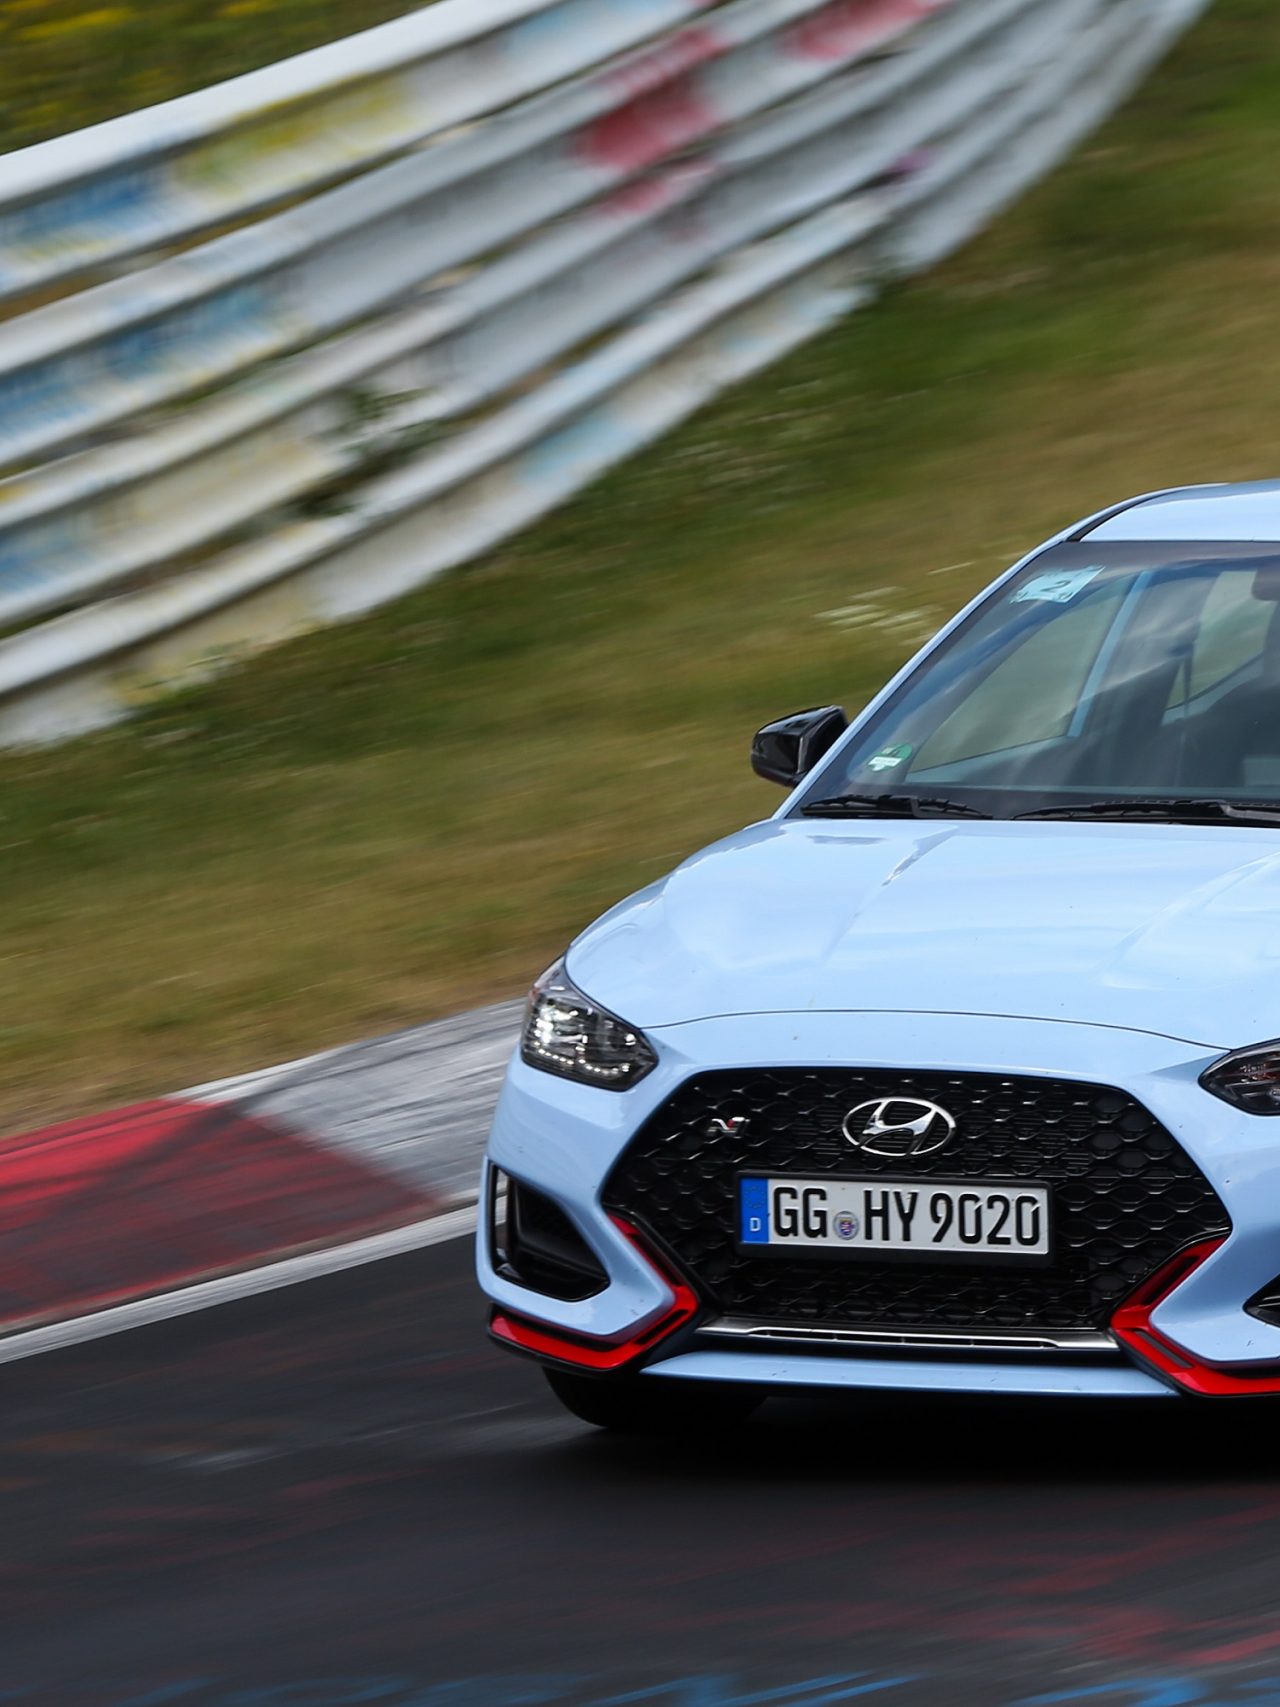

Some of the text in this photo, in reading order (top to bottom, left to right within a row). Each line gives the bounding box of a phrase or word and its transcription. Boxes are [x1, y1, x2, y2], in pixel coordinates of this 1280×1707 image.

[750, 1186, 1041, 1246] D GG HY 9020
